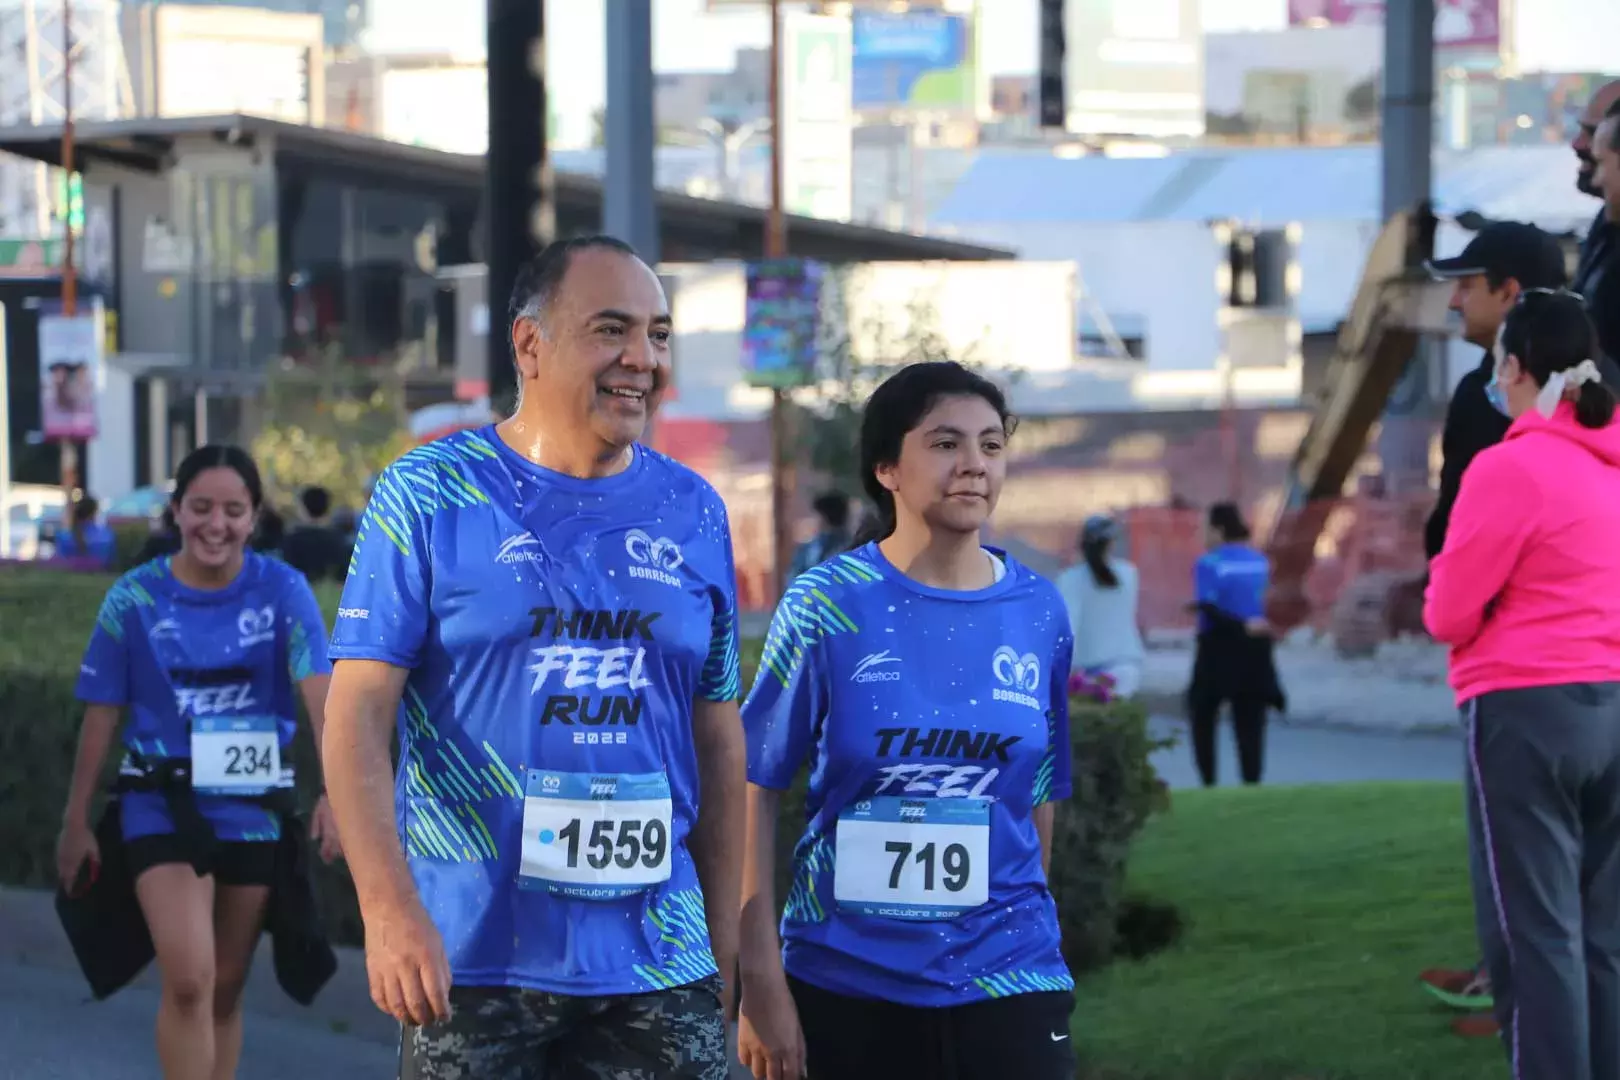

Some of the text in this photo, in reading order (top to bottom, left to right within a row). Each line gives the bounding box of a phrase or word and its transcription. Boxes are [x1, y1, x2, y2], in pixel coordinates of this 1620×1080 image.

[528, 606, 662, 641] THINK
[526, 645, 653, 695] FEEL
[175, 682, 257, 717] FEEL
[540, 696, 641, 725] RUN
[573, 732, 627, 744] 2022
[874, 728, 1024, 762] THINK
[224, 745, 272, 775] 234
[874, 763, 1000, 801] FEEL
[559, 818, 667, 870] 1559
[885, 841, 970, 892] 719
[879, 908, 930, 918] octubre
